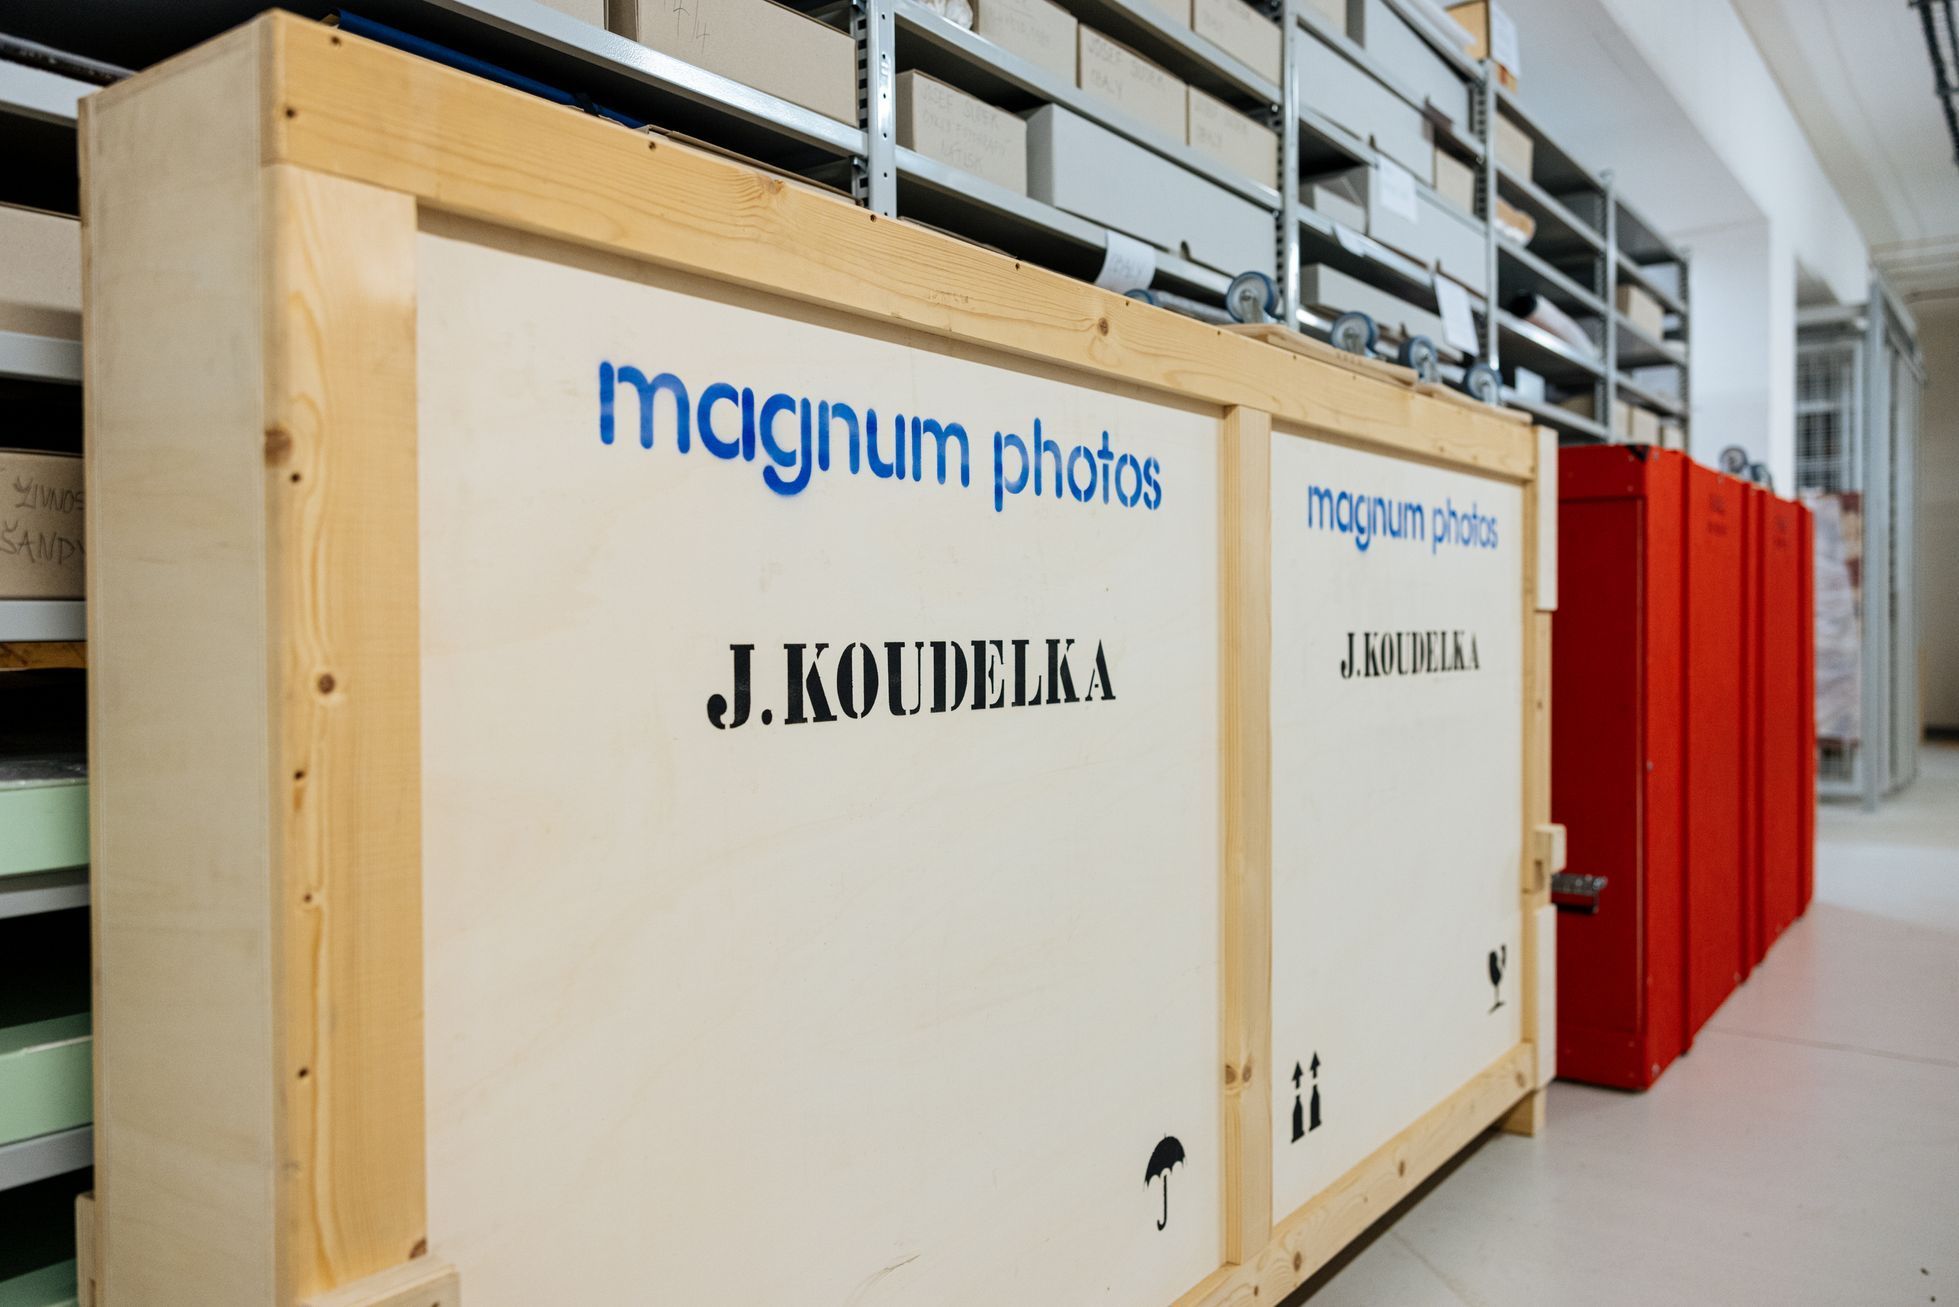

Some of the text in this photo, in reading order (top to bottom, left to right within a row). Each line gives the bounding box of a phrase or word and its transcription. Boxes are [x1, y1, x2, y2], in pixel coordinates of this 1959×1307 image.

[599, 360, 1162, 512] magnum photos
[1307, 485, 1499, 554] magnum photos
[706, 638, 1116, 730] J.KOUDELKA
